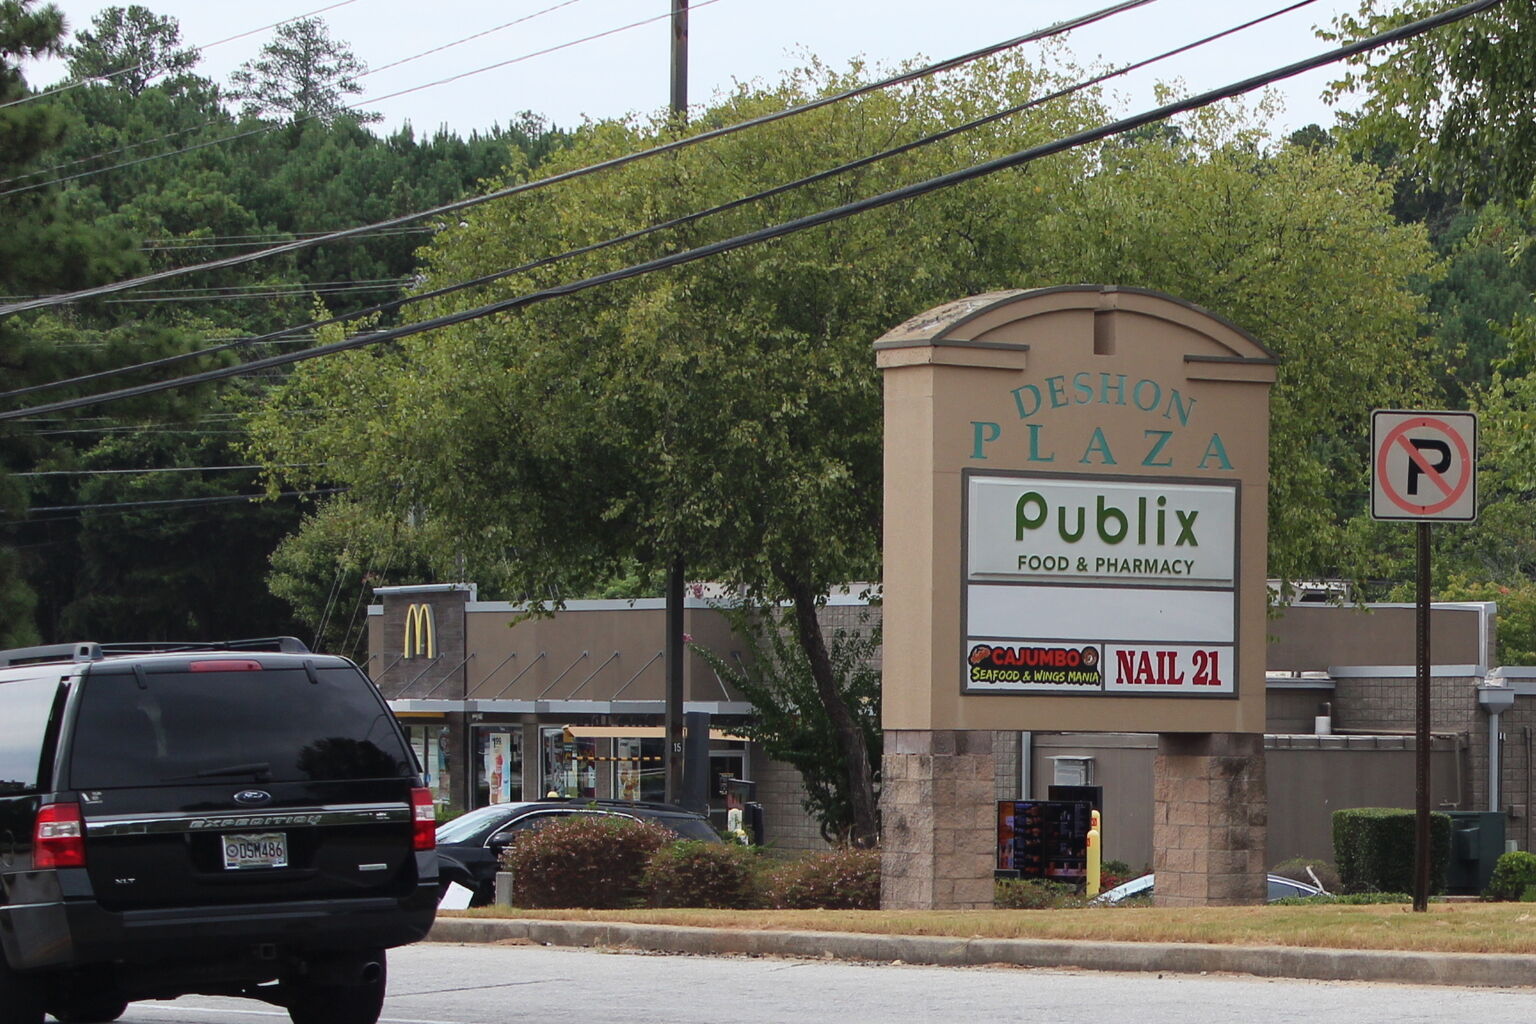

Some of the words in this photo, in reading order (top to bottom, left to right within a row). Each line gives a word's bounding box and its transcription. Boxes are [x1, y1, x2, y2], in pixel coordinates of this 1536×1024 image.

[1011, 372, 1197, 427] DESHON
[969, 420, 1234, 470] PLAZA
[1407, 438, 1452, 495] P
[1015, 491, 1199, 547] Publix
[1018, 555, 1069, 572] FOOD
[1076, 557, 1088, 572] &
[1096, 557, 1195, 575] PHARMACY
[991, 648, 1080, 667] CAJUMBO
[1022, 670, 1031, 681] &
[1067, 671, 1099, 684] MANIA
[1116, 650, 1185, 686] NAIL
[1192, 650, 1222, 686] 21
